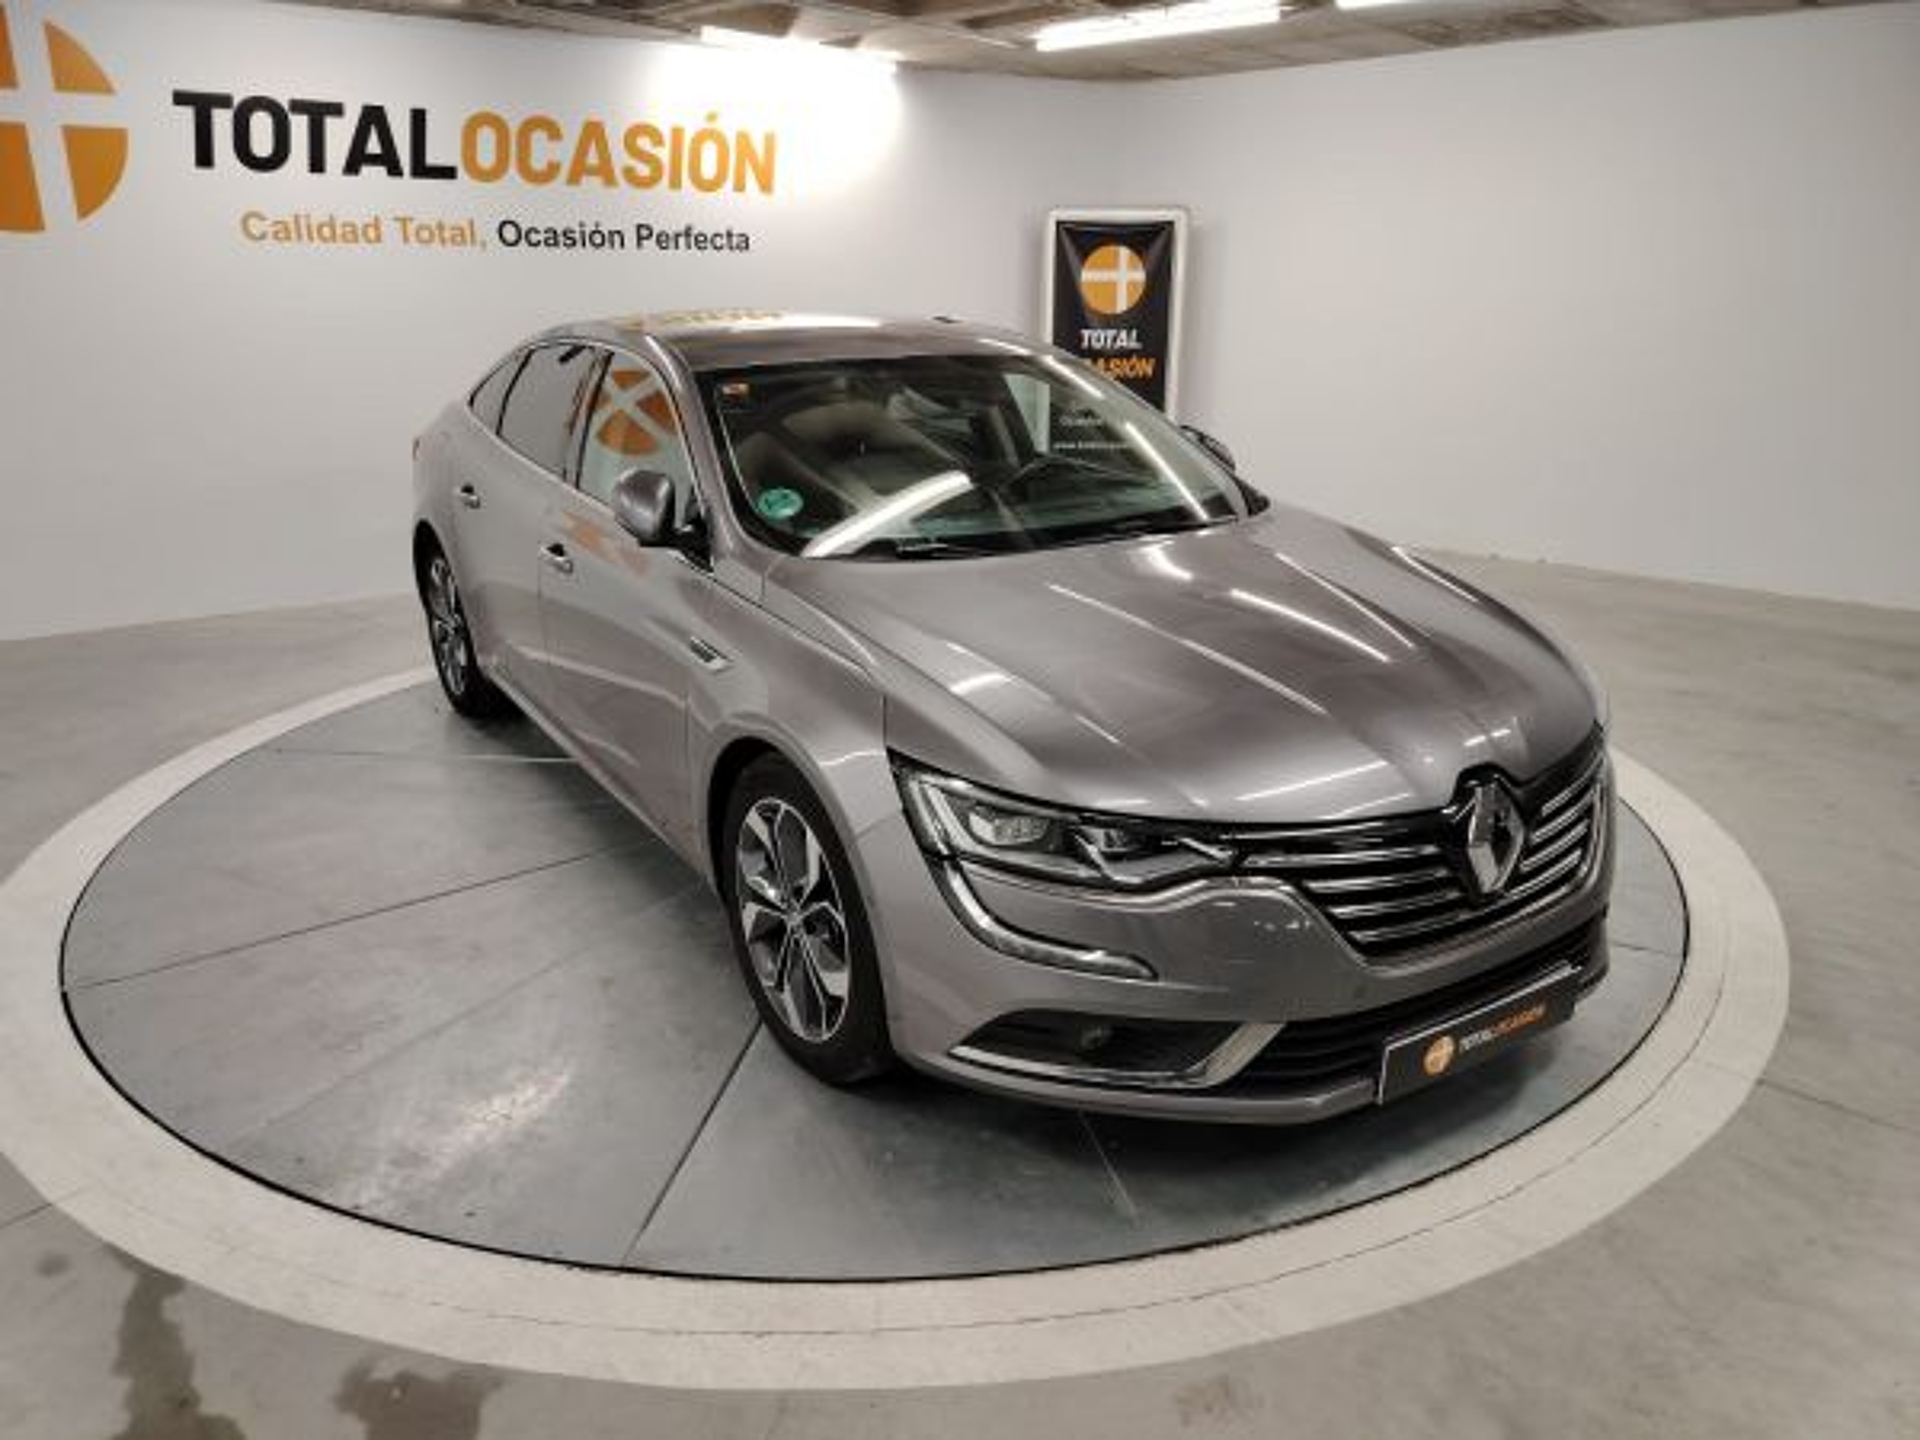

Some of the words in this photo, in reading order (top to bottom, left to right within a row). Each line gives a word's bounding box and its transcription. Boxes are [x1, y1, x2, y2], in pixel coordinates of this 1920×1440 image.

[240, 210, 383, 245] Calidad
[396, 214, 488, 249] Total,
[497, 219, 626, 250] Ocasión
[634, 222, 751, 252] Perfecta
[1080, 328, 1143, 350] TOTAL
